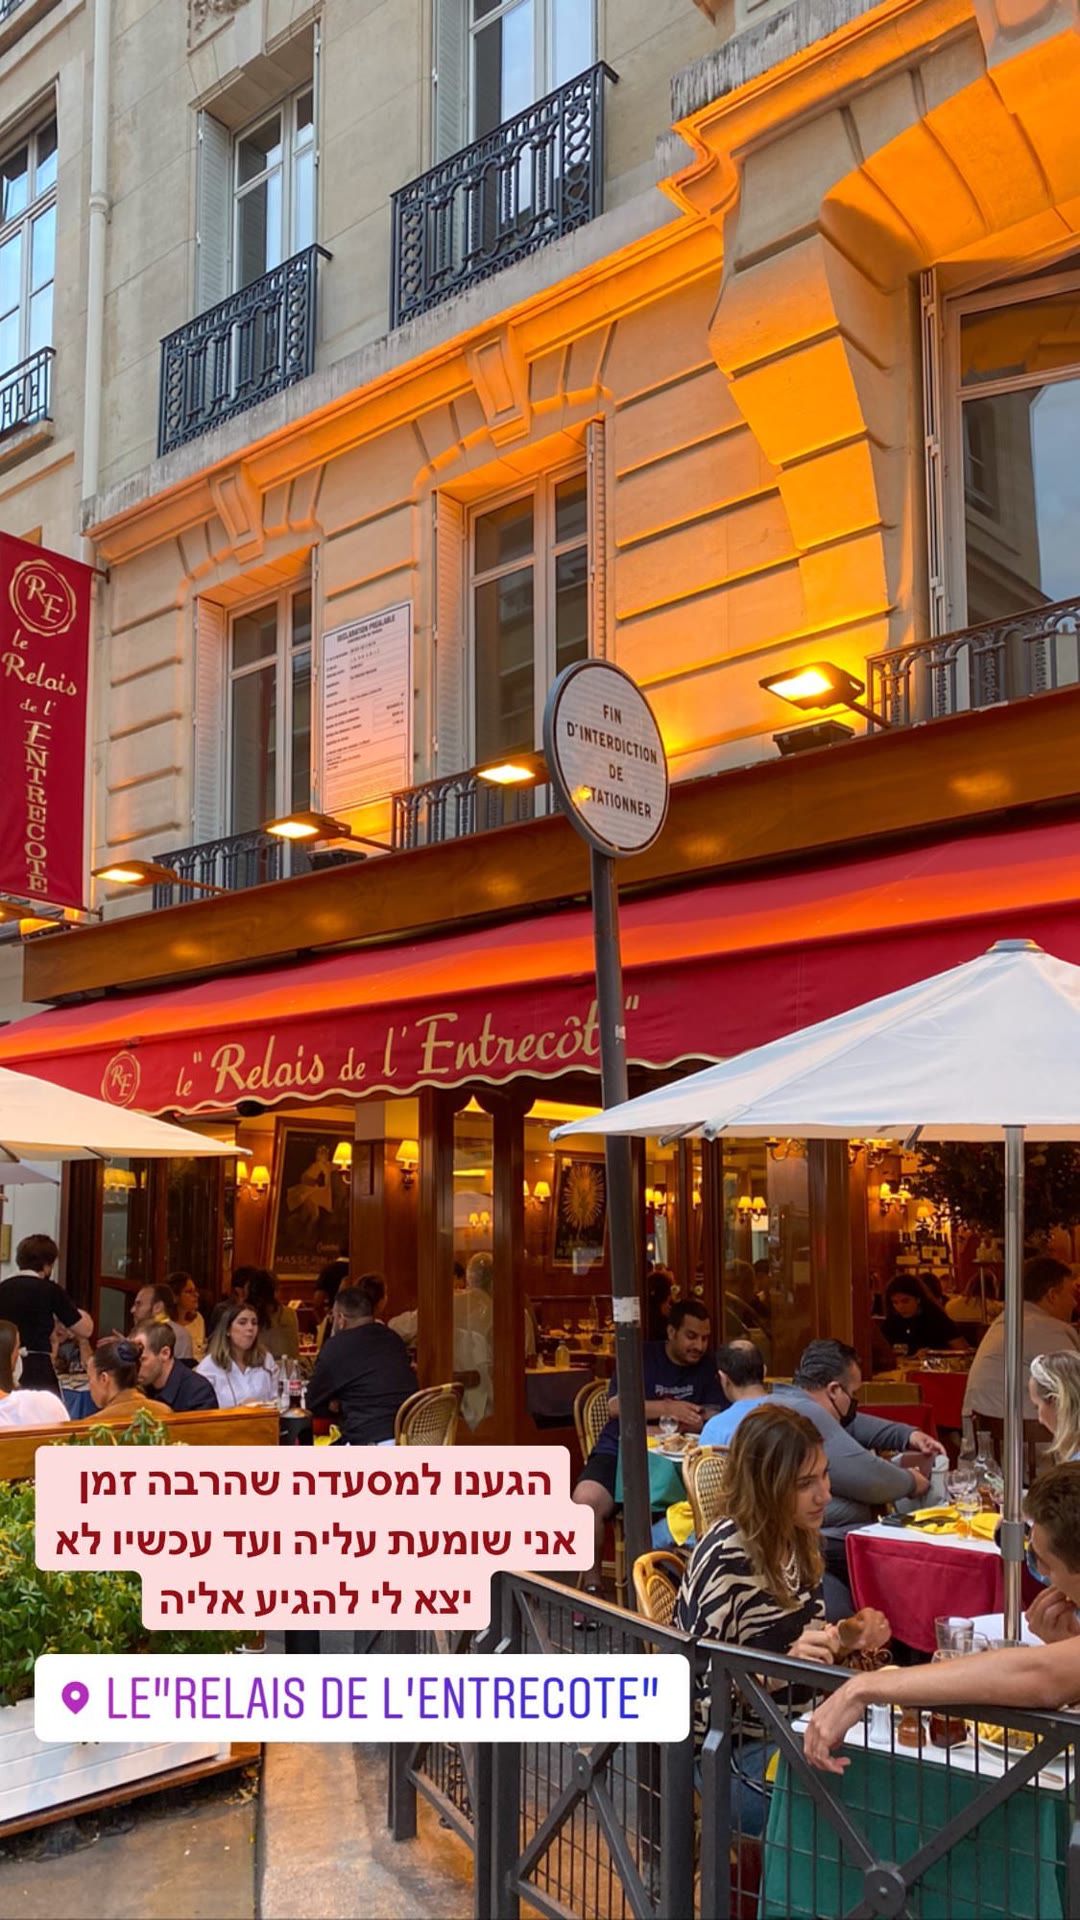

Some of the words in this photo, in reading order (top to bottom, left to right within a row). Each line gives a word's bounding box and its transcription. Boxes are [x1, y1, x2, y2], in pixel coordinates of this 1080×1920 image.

[12, 629, 29, 650] le
[1, 652, 77, 696] Relais
[19, 698, 38, 713] de
[602, 704, 622, 725] FIN
[566, 721, 658, 765] D'INTERDICTION
[608, 763, 624, 782] DE
[23, 720, 52, 894] ENTRECOTE
[337, 1046, 366, 1082] de
